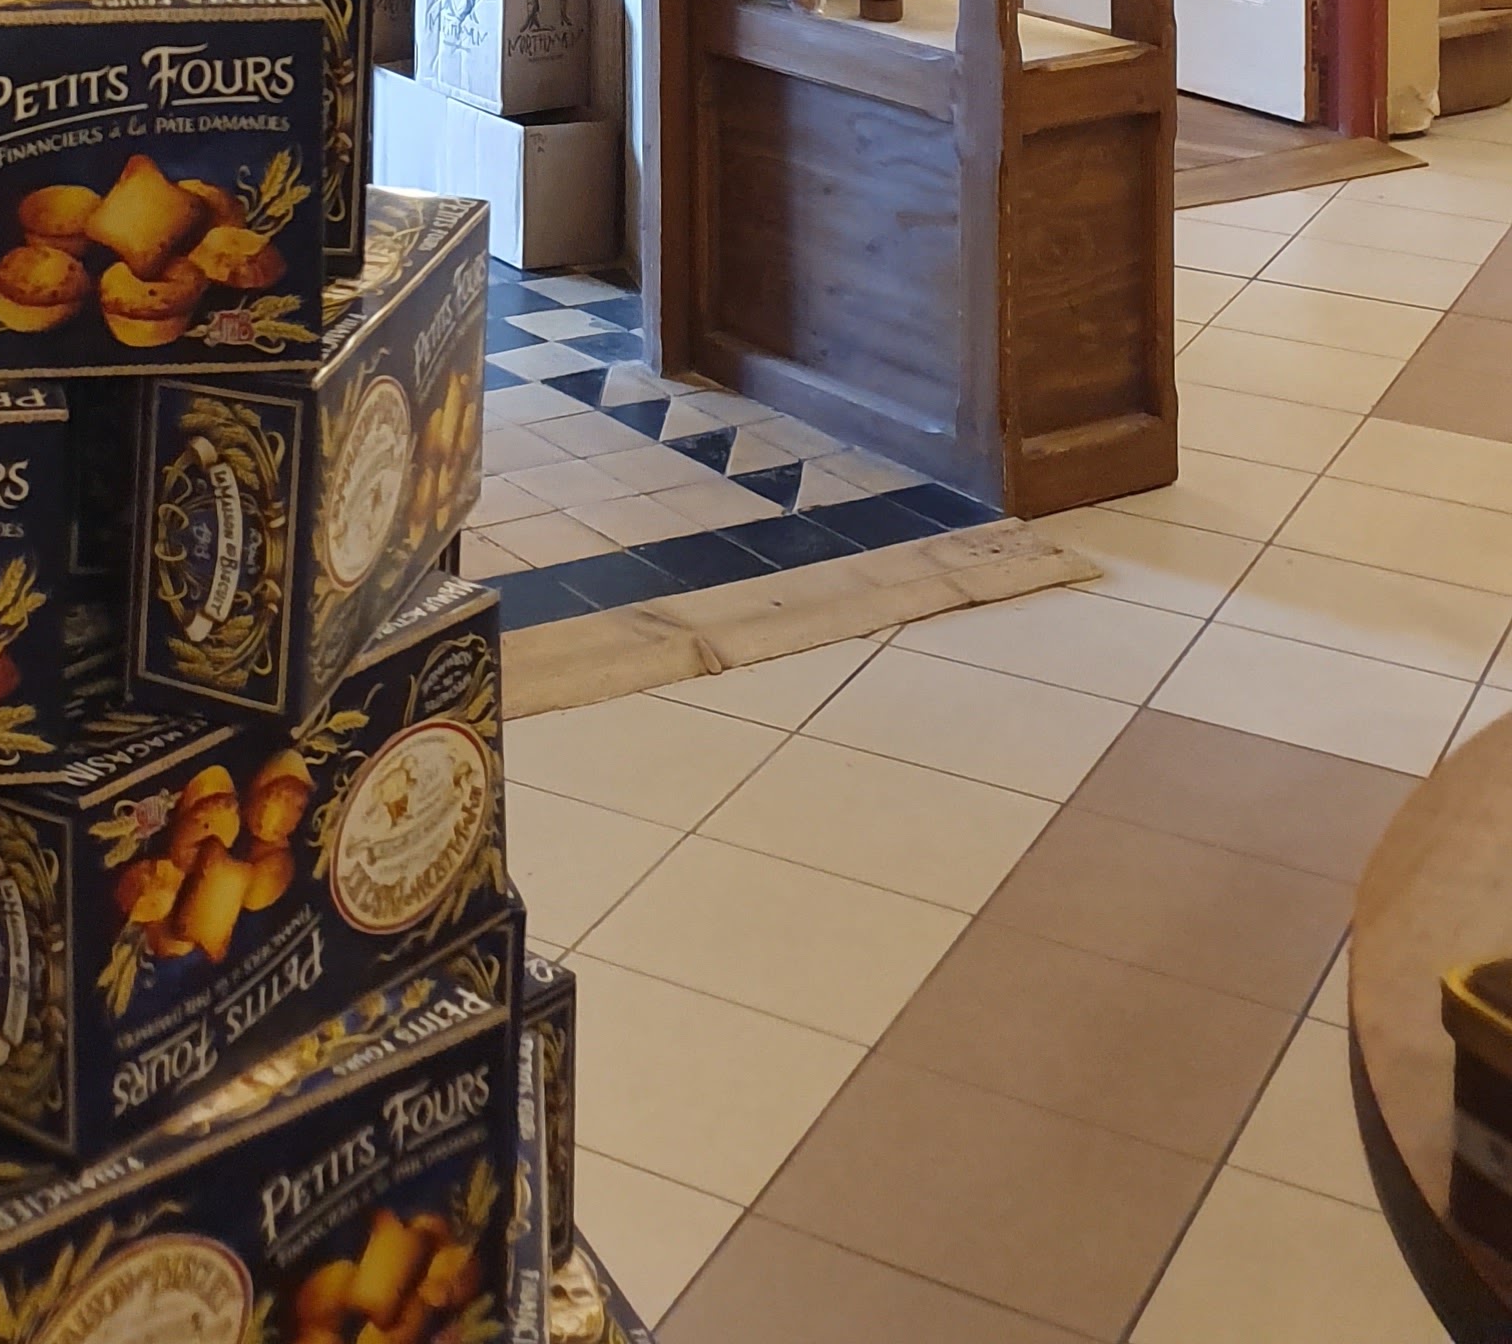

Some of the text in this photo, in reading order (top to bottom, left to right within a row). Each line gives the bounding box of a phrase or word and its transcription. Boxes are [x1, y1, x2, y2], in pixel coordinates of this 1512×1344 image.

[141, 41, 296, 110] FOURS
[210, 556, 238, 617] BISCUIT
[65, 726, 184, 787] MAGASIN
[111, 1017, 220, 1118] FOURS
[225, 928, 327, 1046] PETITS
[261, 1125, 380, 1246] PETITS
[383, 1064, 491, 1152] FOURS
